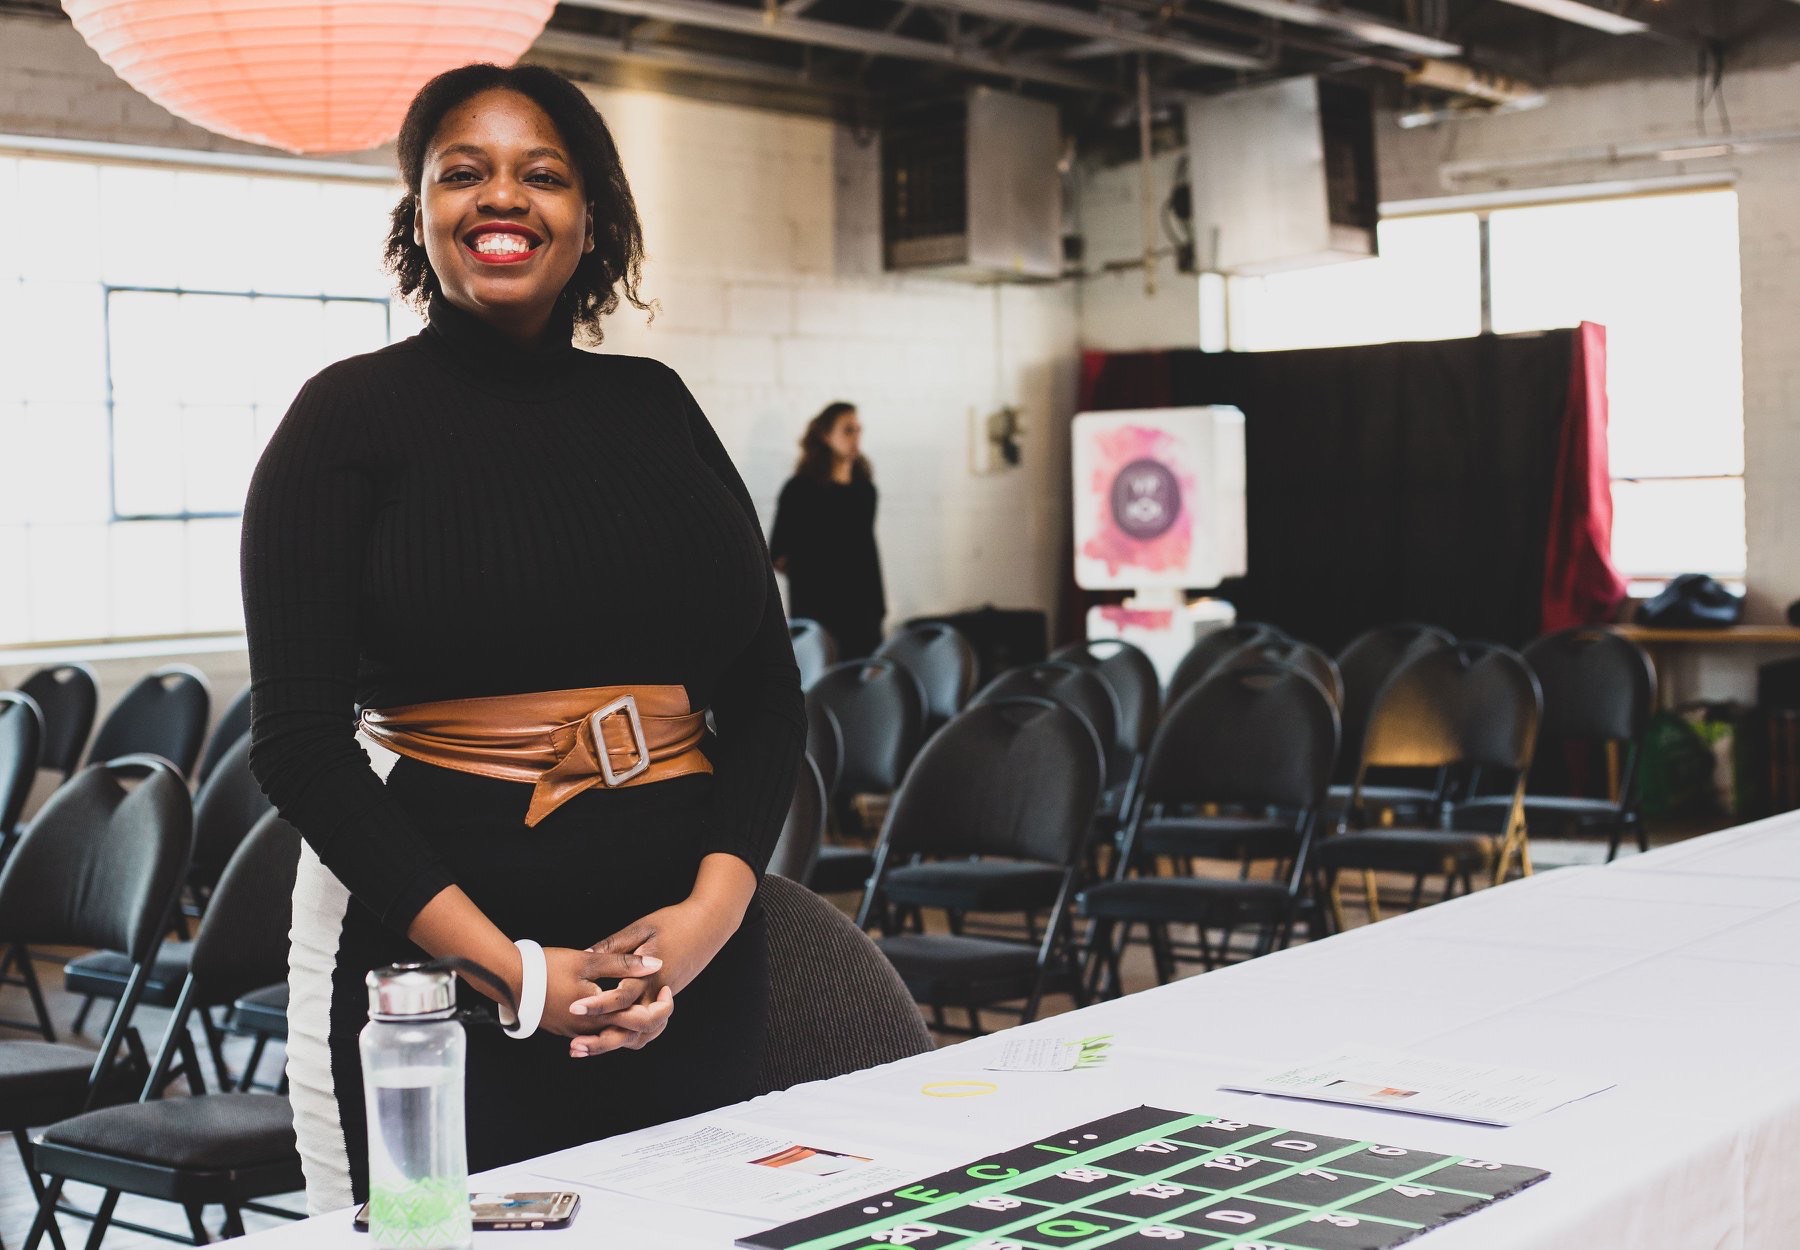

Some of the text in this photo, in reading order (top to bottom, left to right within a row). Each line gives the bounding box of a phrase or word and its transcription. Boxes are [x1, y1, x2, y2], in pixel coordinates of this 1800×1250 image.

[1198, 1118, 1249, 1132] 16
[1135, 1139, 1179, 1154] 17
[1272, 1139, 1317, 1152] D
[1368, 1145, 1407, 1157] 6
[1204, 1154, 1260, 1172] 12
[1457, 1158, 1503, 1170] 5
[1299, 1168, 1338, 1182] 7
[1129, 1182, 1185, 1199] 13
[1393, 1185, 1435, 1198] 4
[1205, 1209, 1256, 1225] D
[1310, 1213, 1360, 1227] 3
[871, 1222, 938, 1246] 20
[1036, 1219, 1110, 1238] Q
